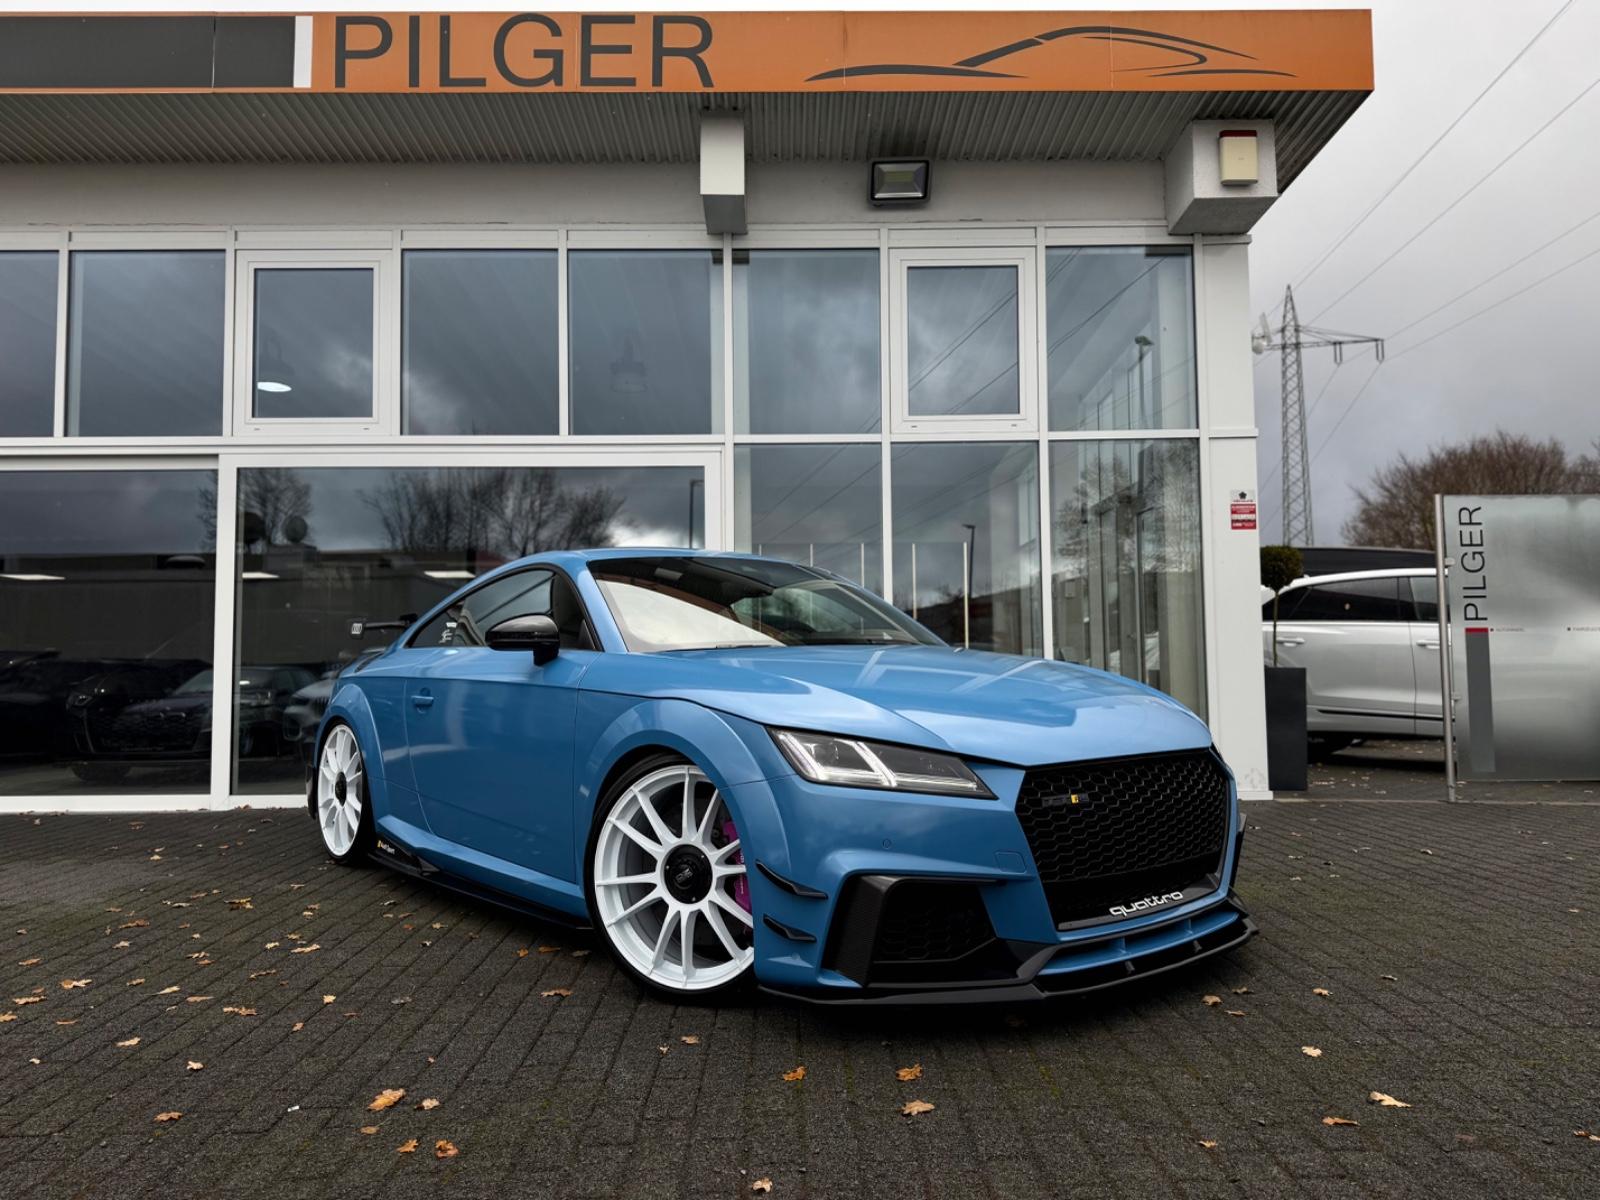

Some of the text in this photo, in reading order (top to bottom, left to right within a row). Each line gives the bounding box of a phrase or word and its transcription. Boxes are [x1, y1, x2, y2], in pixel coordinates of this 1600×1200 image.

[335, 13, 714, 88] PILGER
[1458, 506, 1488, 621] PILGER
[1109, 891, 1183, 917] quattro
